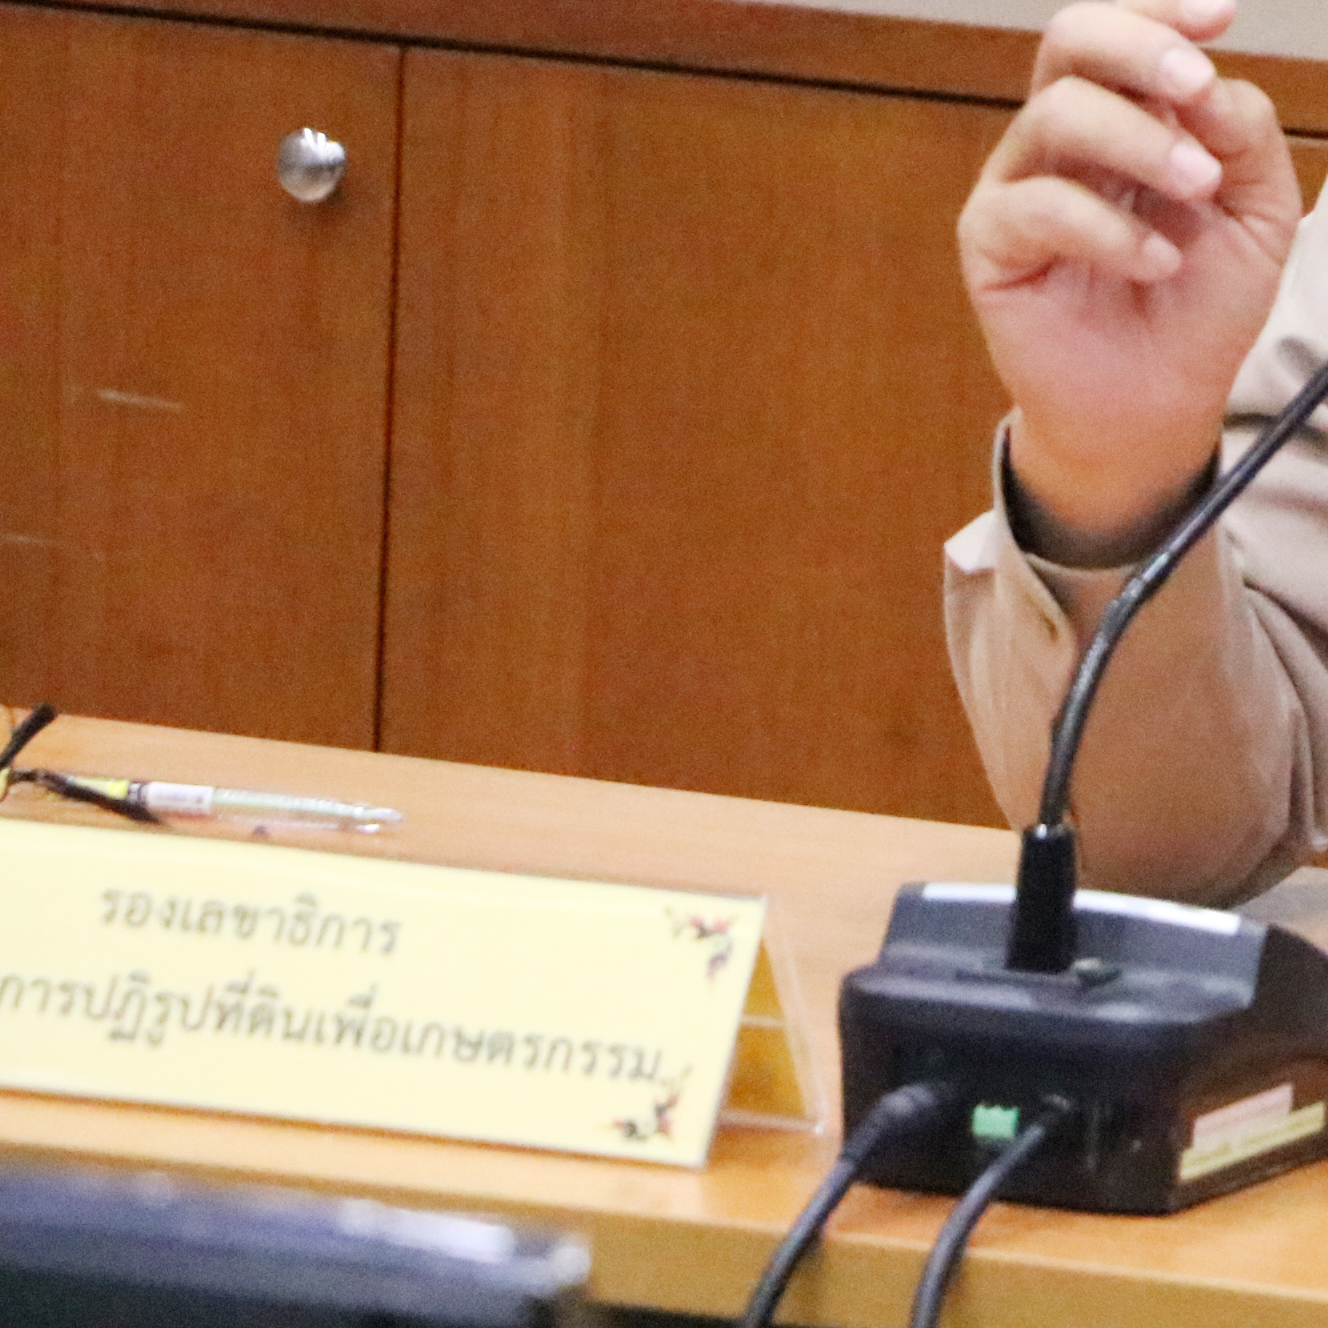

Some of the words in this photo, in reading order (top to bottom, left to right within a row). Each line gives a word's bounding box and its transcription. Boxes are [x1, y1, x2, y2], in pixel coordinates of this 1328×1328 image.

[100, 888, 401, 955] รองเลขาธิการ
